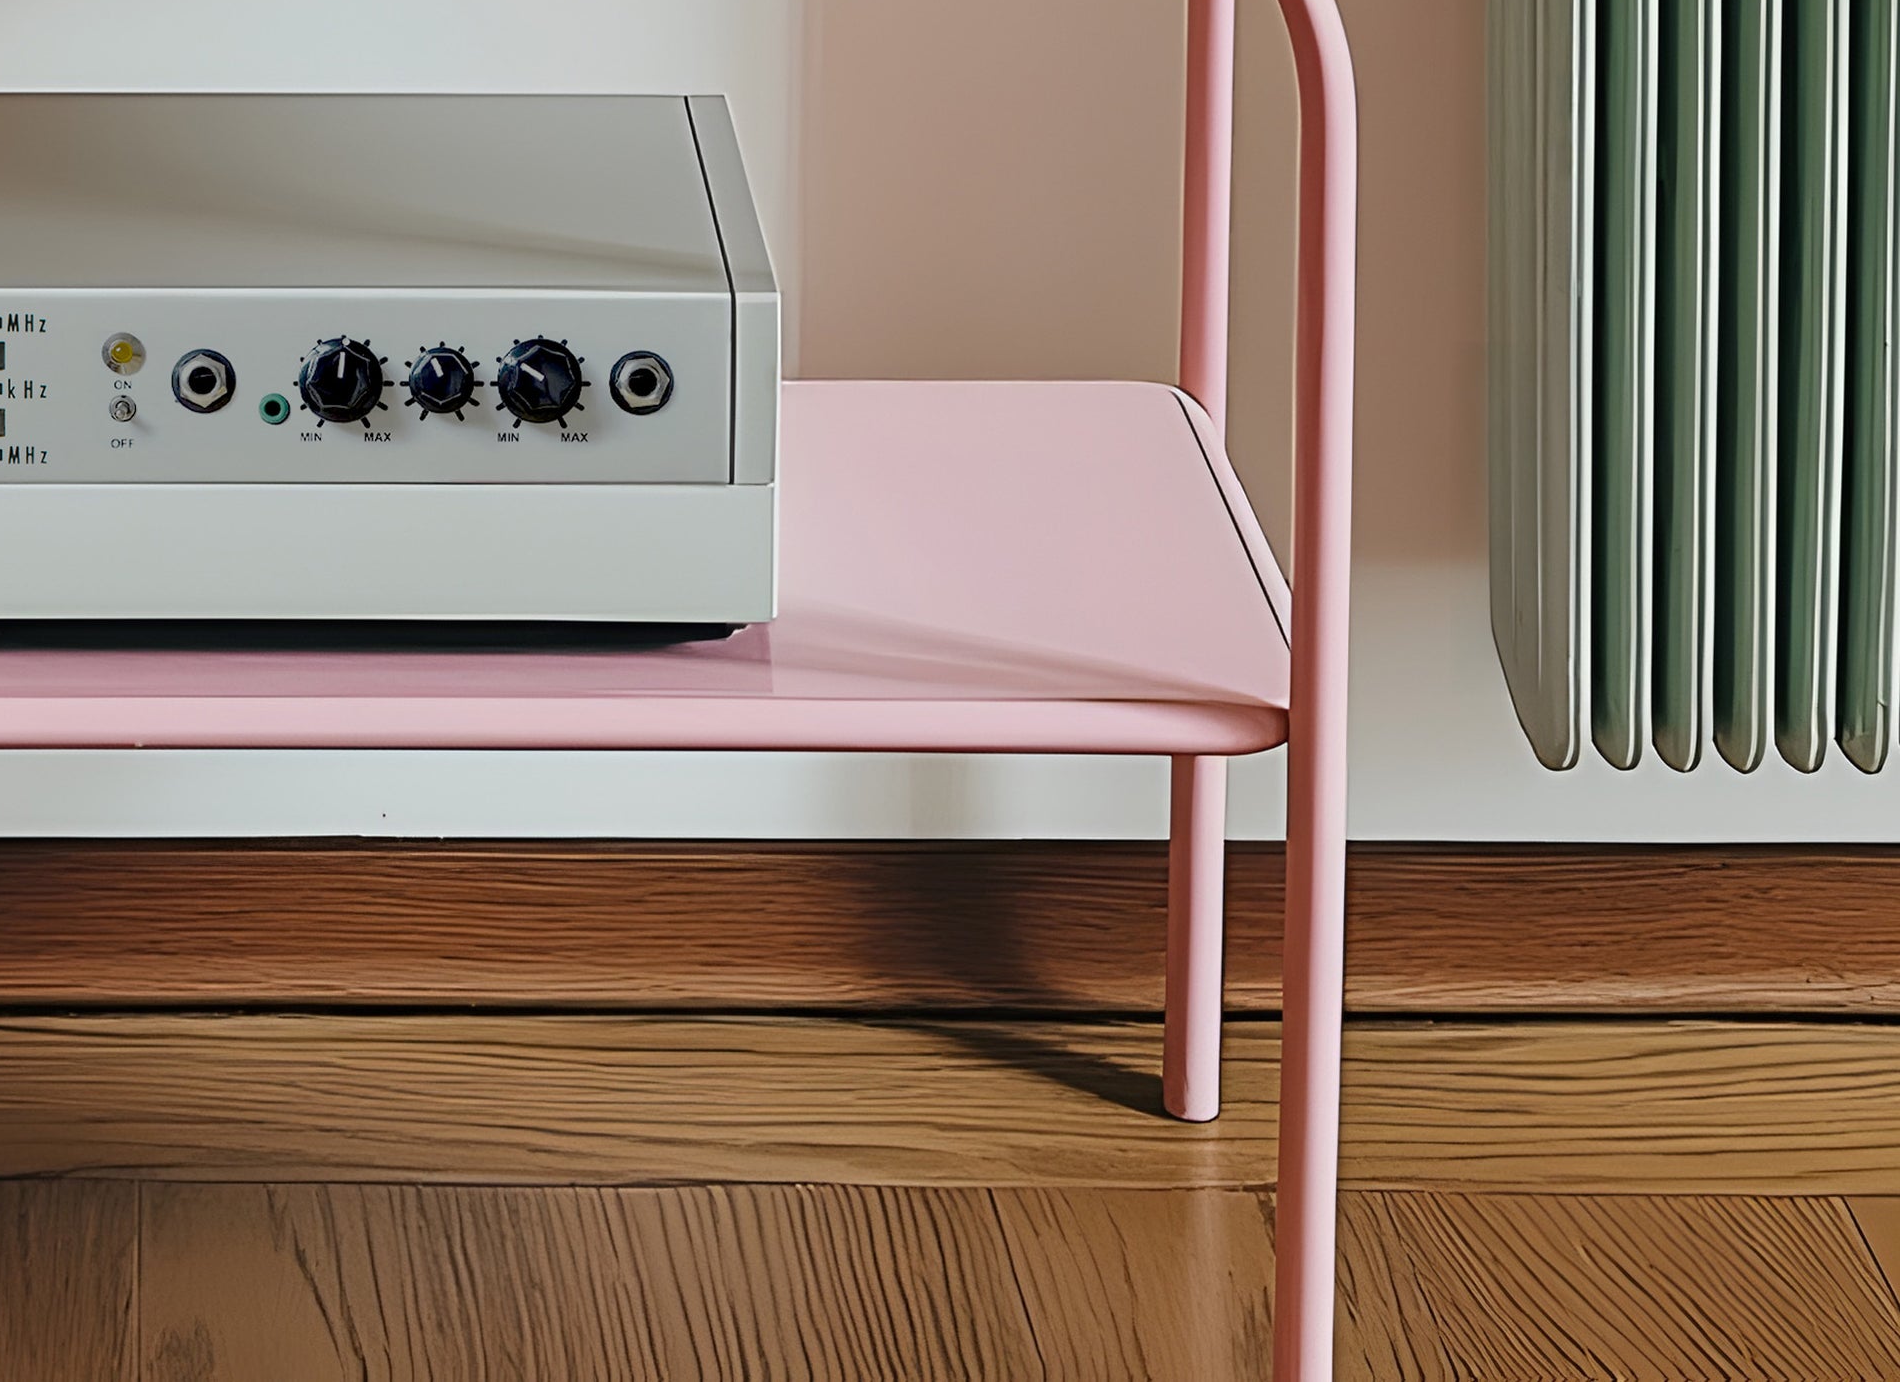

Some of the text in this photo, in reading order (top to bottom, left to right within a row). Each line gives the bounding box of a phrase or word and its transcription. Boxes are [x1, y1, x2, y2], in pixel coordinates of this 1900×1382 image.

[7, 313, 46, 333] MHz
[7, 378, 46, 399] kHz
[114, 380, 132, 390] ON
[300, 432, 392, 442] MIN MAX
[497, 432, 589, 442] MIN MAX
[111, 438, 134, 449] OFF
[8, 446, 47, 464] MHz
